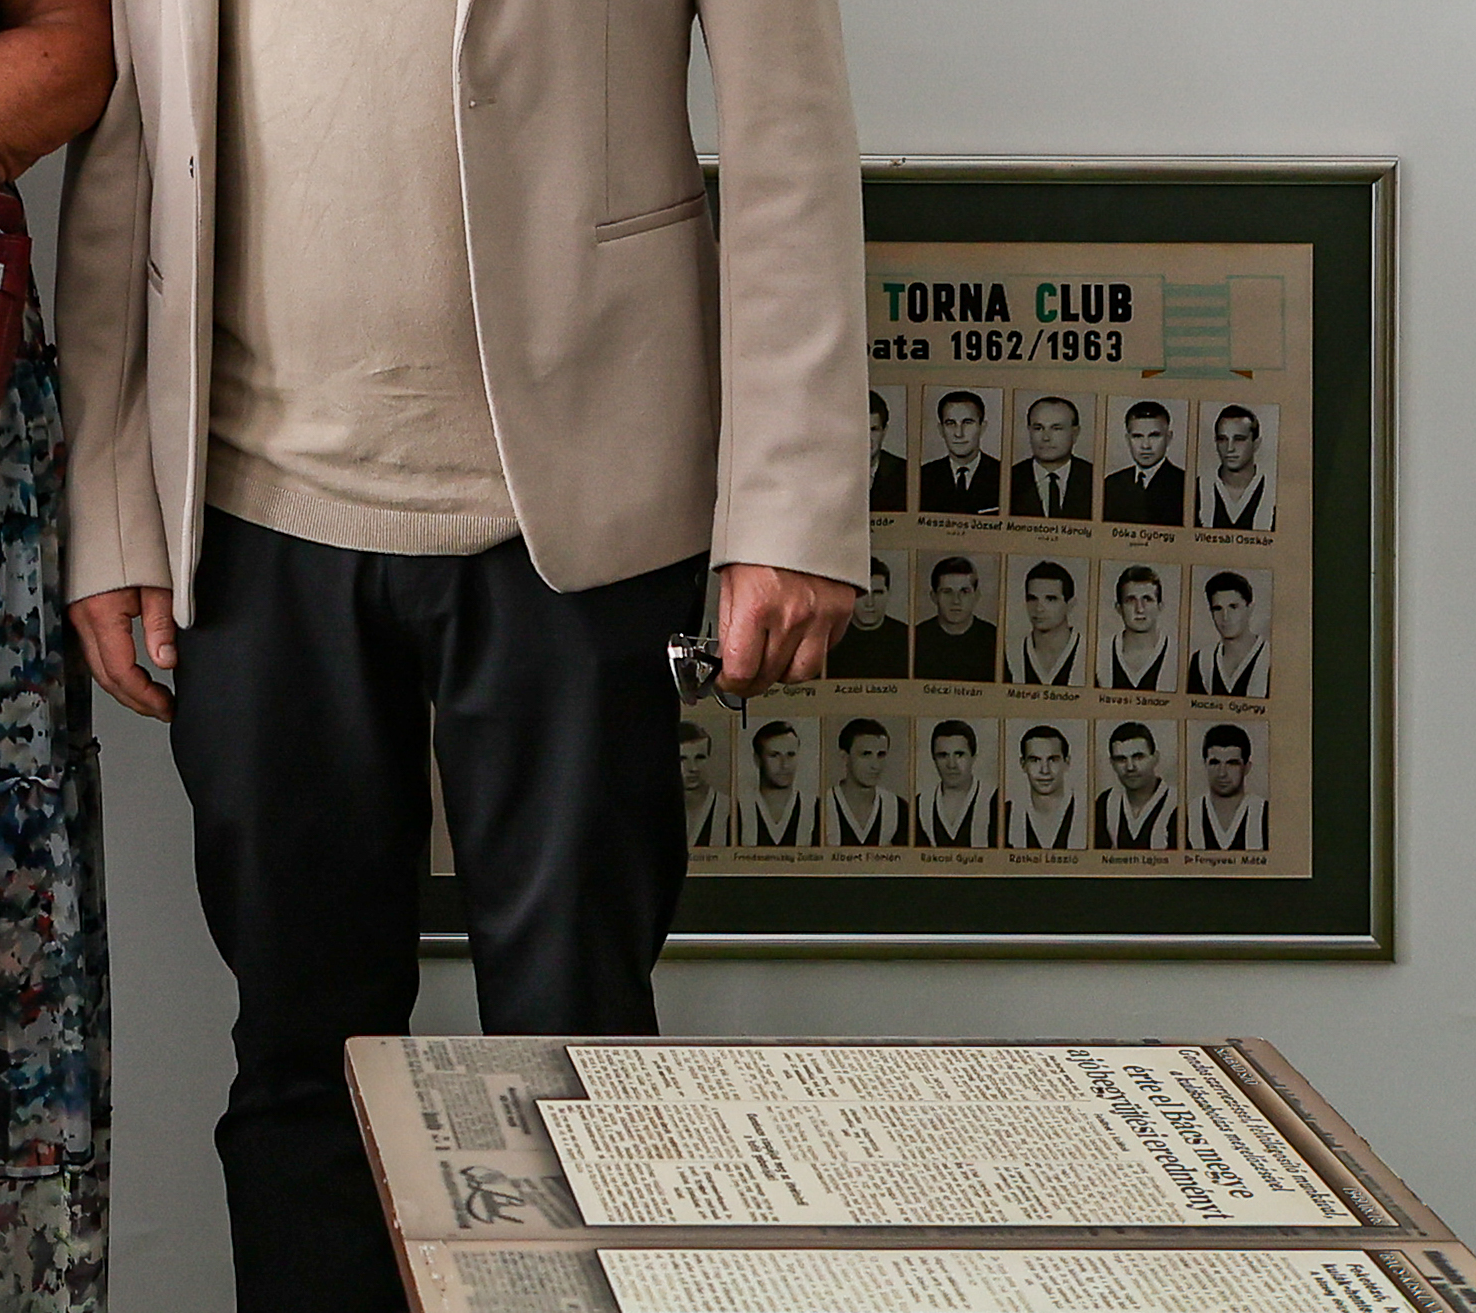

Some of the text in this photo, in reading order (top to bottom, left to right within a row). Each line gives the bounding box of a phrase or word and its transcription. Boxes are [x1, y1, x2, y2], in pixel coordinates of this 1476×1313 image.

[867, 329, 1122, 362] ata 1962/1963
[882, 281, 1133, 323] TORNA CLUB
[1067, 1049, 1234, 1220] a jó begyűjtési eredményt
[1122, 1065, 1254, 1199] érte el Bács megye
